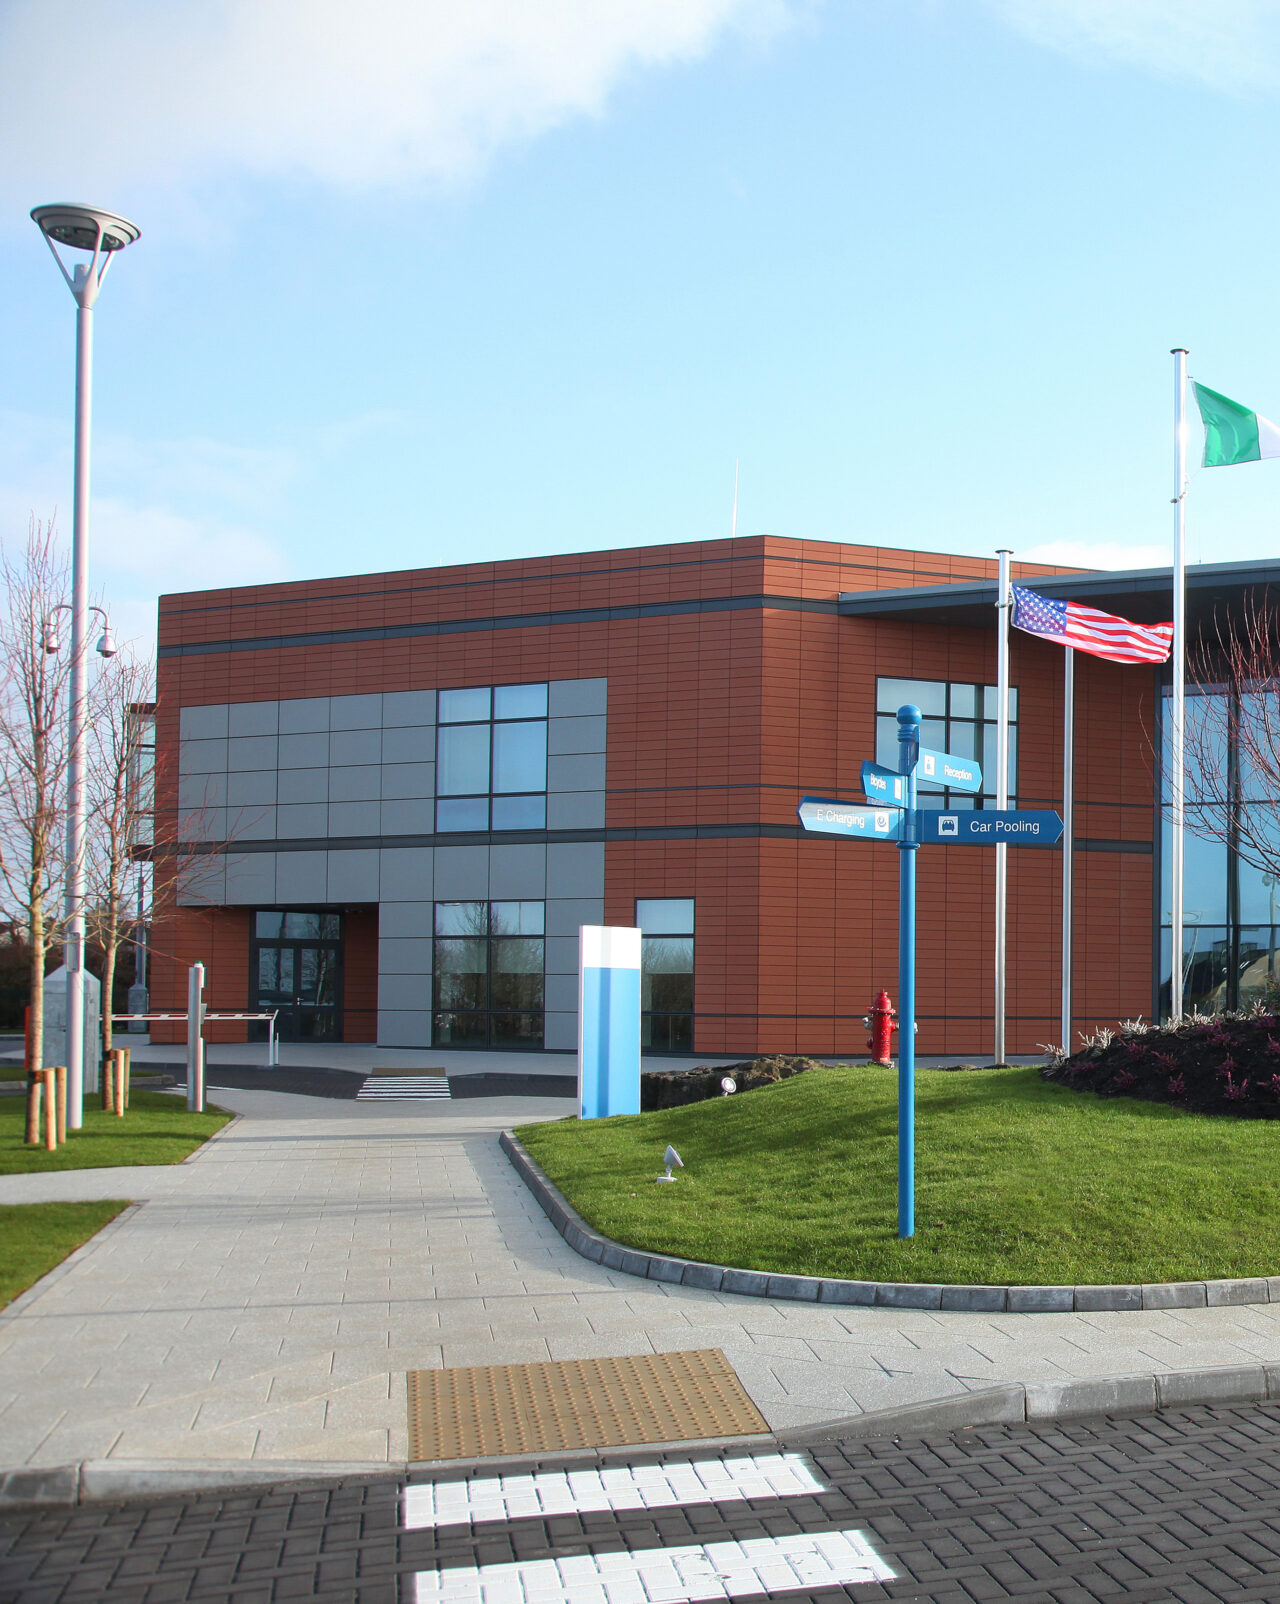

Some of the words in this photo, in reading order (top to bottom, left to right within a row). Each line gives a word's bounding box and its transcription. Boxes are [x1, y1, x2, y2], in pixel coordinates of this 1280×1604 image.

[944, 764, 973, 782] Reception
[826, 810, 865, 829] Charging
[970, 820, 992, 833] Car
[995, 820, 1040, 835] Pooling
